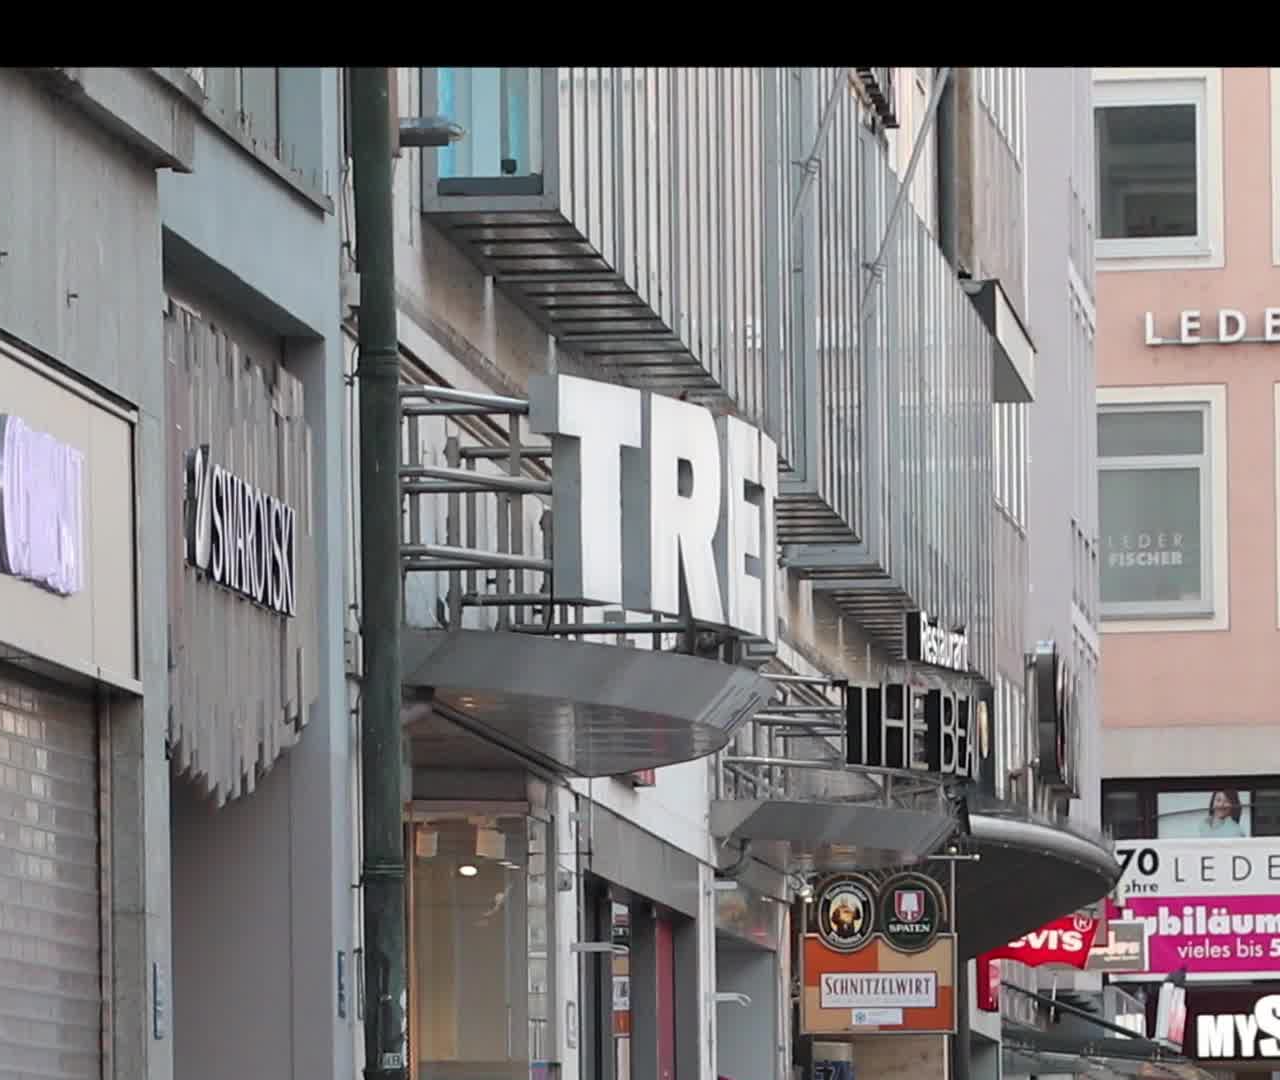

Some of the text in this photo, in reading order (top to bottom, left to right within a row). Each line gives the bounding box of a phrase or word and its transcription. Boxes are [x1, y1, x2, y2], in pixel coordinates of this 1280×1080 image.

[212, 463, 297, 617] SWAROVSKI
[1108, 531, 1185, 549] LEDER
[1109, 550, 1184, 568] FISCHER
[920, 610, 969, 673] Restaurant
[1117, 848, 1159, 876] 70
[888, 923, 931, 934] SPATEN
[1177, 939, 1232, 960] vieles
[1236, 937, 1263, 957] bis
[824, 975, 933, 998] SCHNITZELWIRT
